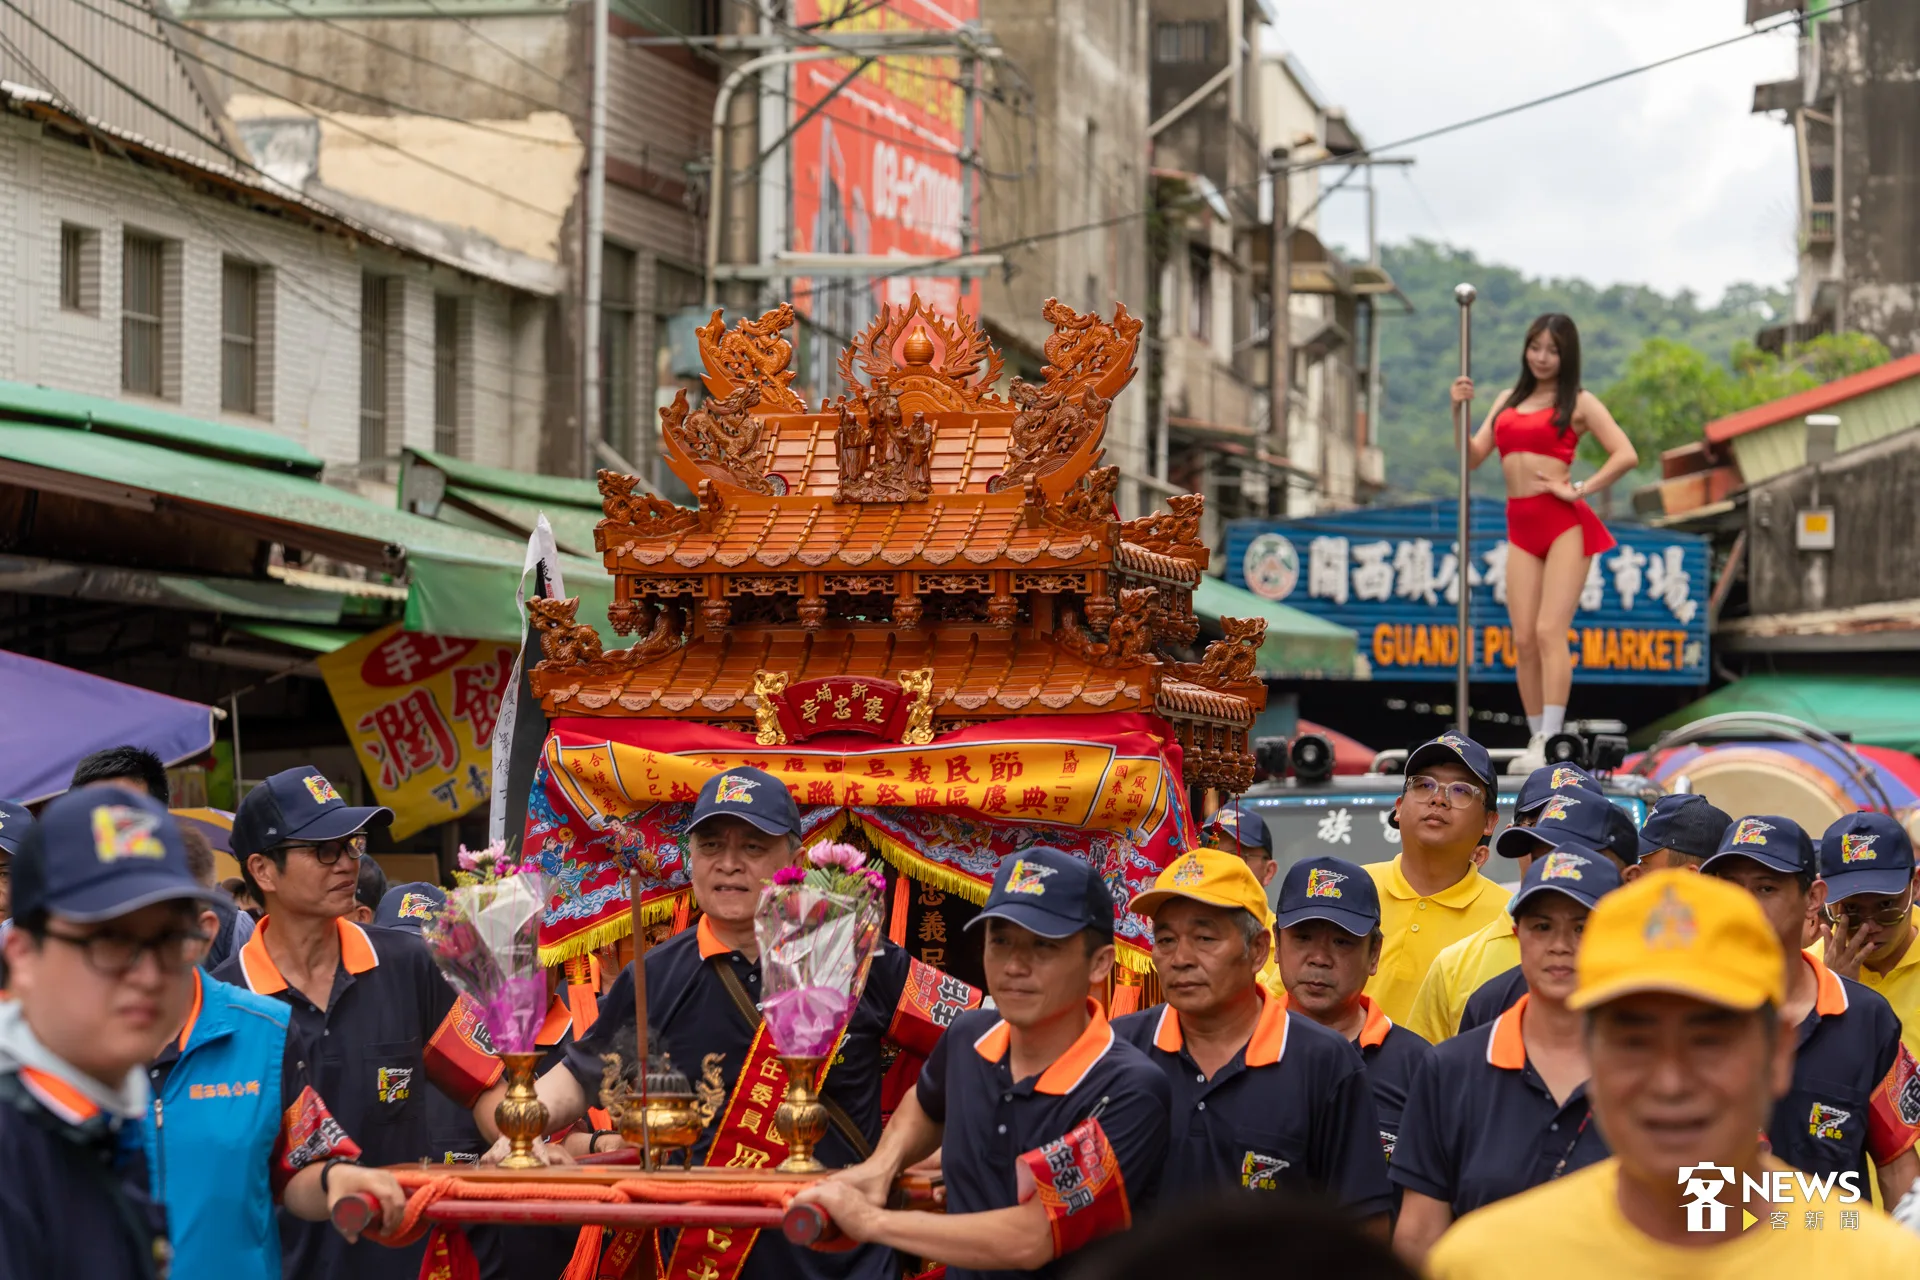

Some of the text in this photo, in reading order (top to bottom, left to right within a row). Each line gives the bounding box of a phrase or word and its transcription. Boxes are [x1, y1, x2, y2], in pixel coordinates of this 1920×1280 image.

[1484, 626, 1580, 668] PUC
[1582, 628, 1687, 671] MARKET
[815, 682, 869, 703] 新埔
[800, 694, 885, 725] 褒忠亭
